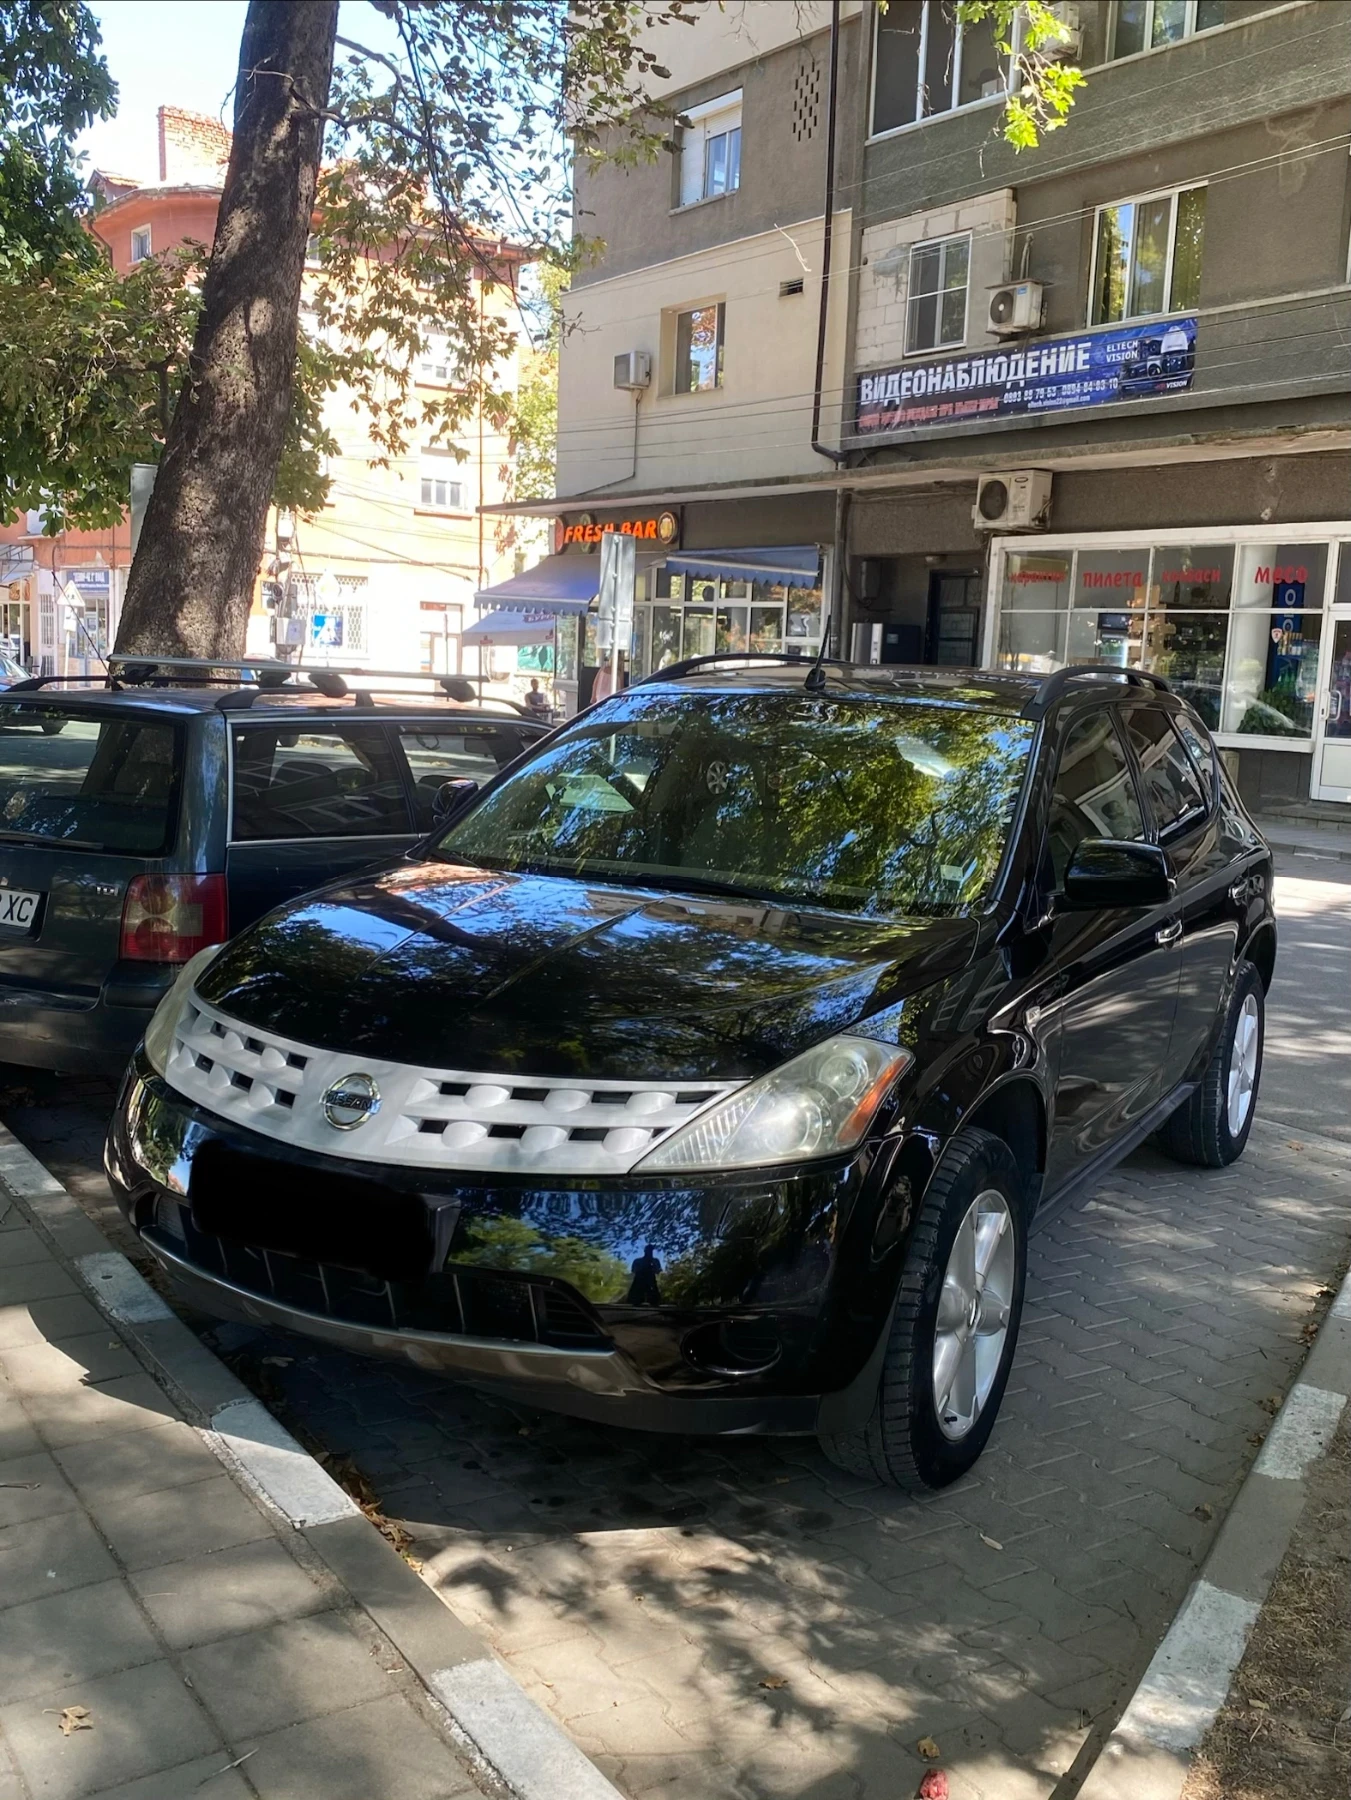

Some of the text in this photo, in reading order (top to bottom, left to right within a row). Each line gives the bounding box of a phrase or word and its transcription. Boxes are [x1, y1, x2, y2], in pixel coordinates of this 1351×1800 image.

[1106, 340, 1138, 352] ELTECH
[1106, 351, 1138, 363] VISION
[860, 342, 1092, 406] ВИДЕОНАБЛЮДЕНИЕ
[564, 520, 657, 544] FRESH BAR
[327, 1092, 371, 1110] NISSAN
